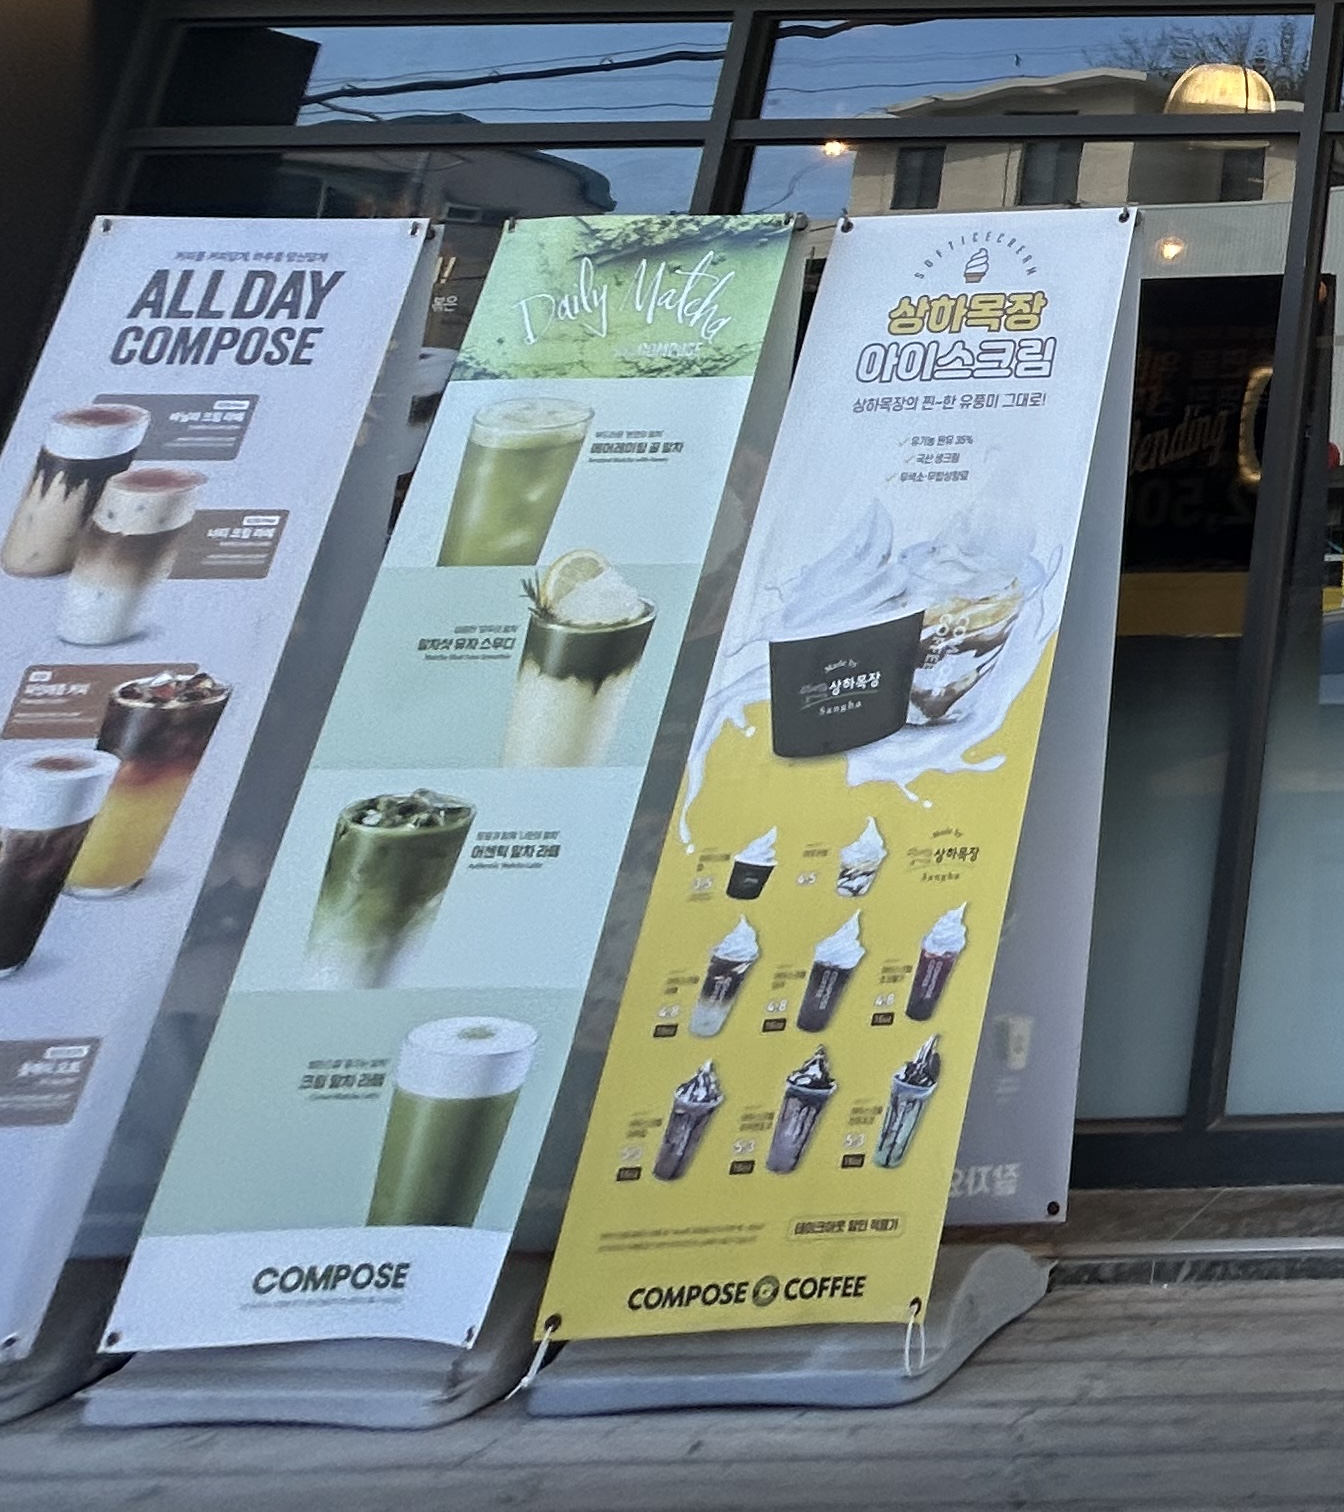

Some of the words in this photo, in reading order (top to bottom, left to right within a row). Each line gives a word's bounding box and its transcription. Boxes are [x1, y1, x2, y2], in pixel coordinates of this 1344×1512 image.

[127, 269, 224, 320] ALL
[231, 270, 345, 320] DAY
[512, 256, 608, 345] Daily
[624, 250, 735, 343] Matcha
[888, 291, 1048, 336] 상하목장
[110, 326, 323, 366] COMPOSE
[856, 337, 1057, 383] 아이스크림
[853, 395, 919, 413] 상하목장의
[1002, 392, 1047, 408] 그대로!
[829, 671, 882, 696] 상하목장
[934, 846, 980, 863] 상하목장
[252, 1261, 410, 1295] COMPOSE
[628, 1281, 749, 1311] COMPOSE
[784, 1275, 867, 1301] COFFEE
